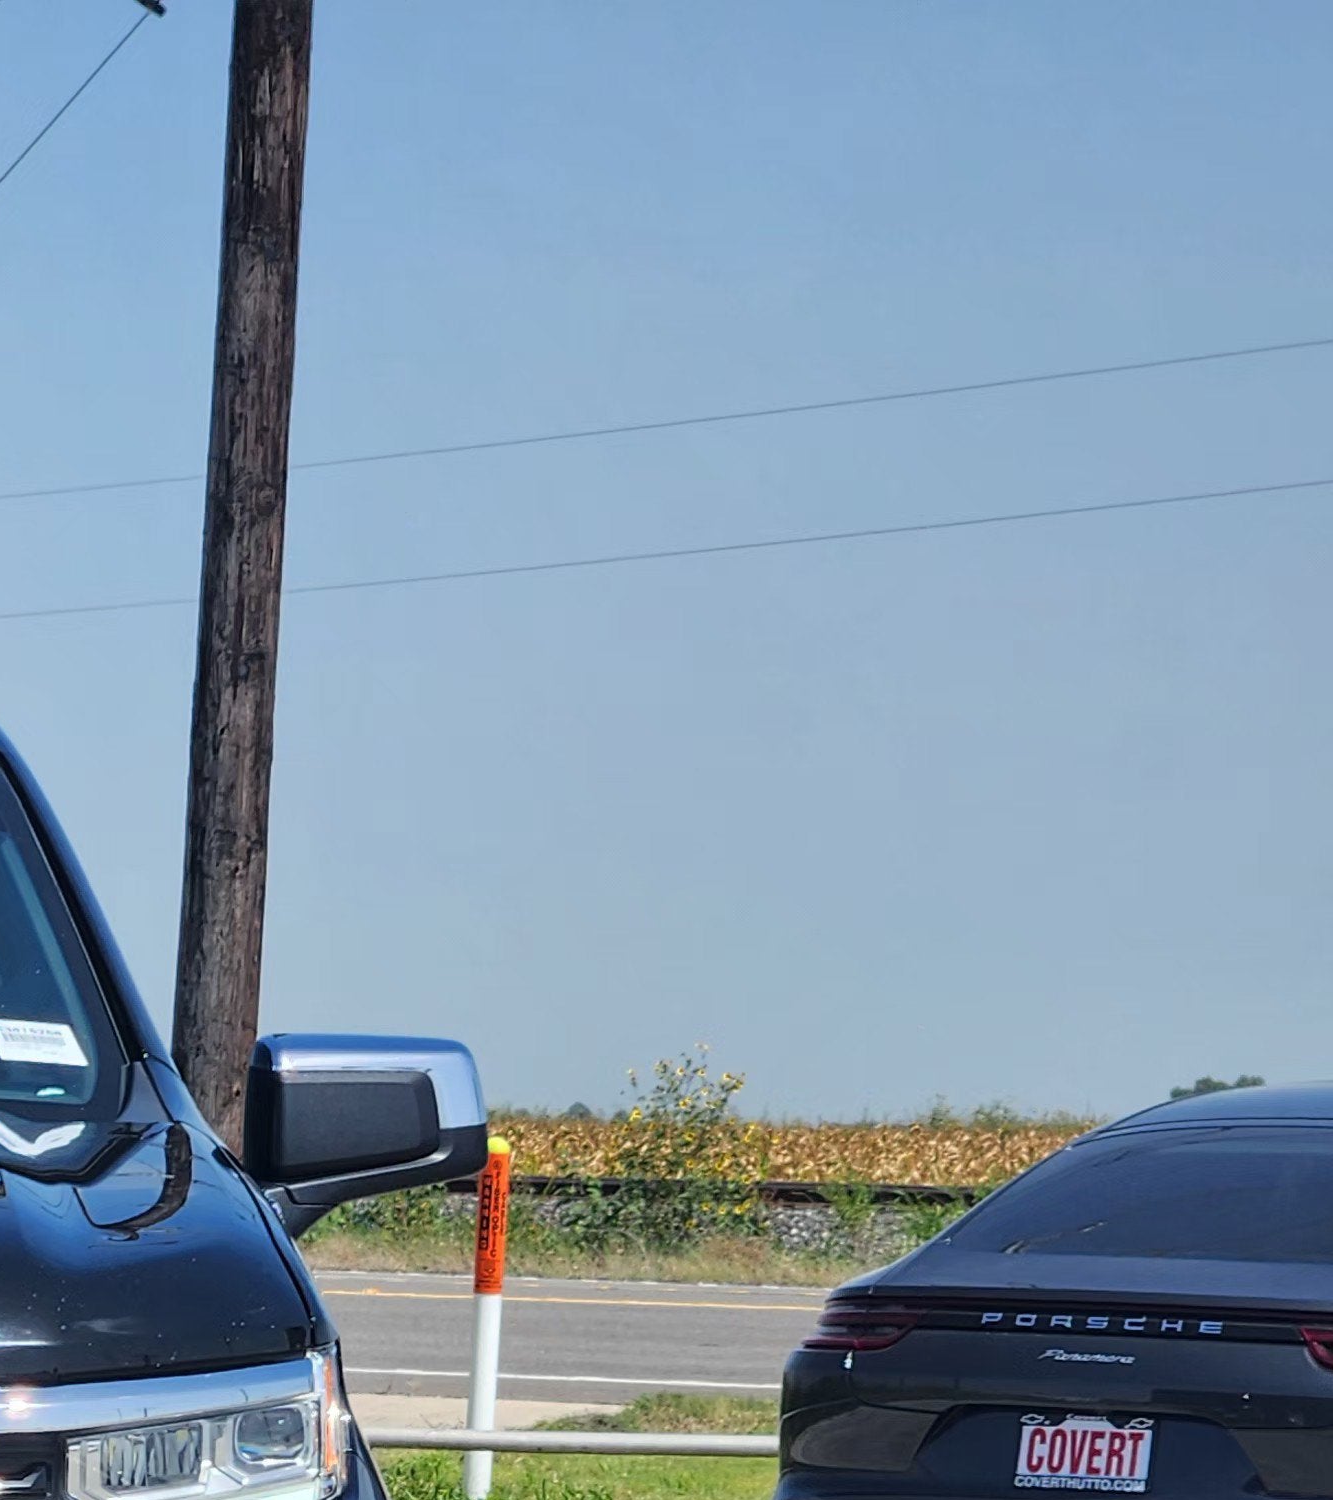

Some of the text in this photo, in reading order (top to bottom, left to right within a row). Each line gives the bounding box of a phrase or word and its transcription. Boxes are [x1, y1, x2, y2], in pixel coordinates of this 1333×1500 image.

[981, 1312, 1223, 1335] PORSCHE
[1037, 1349, 1136, 1364] Panamera
[1026, 1427, 1145, 1477] COVERT
[1014, 1475, 1146, 1493] COVERTHUTTO.COM
